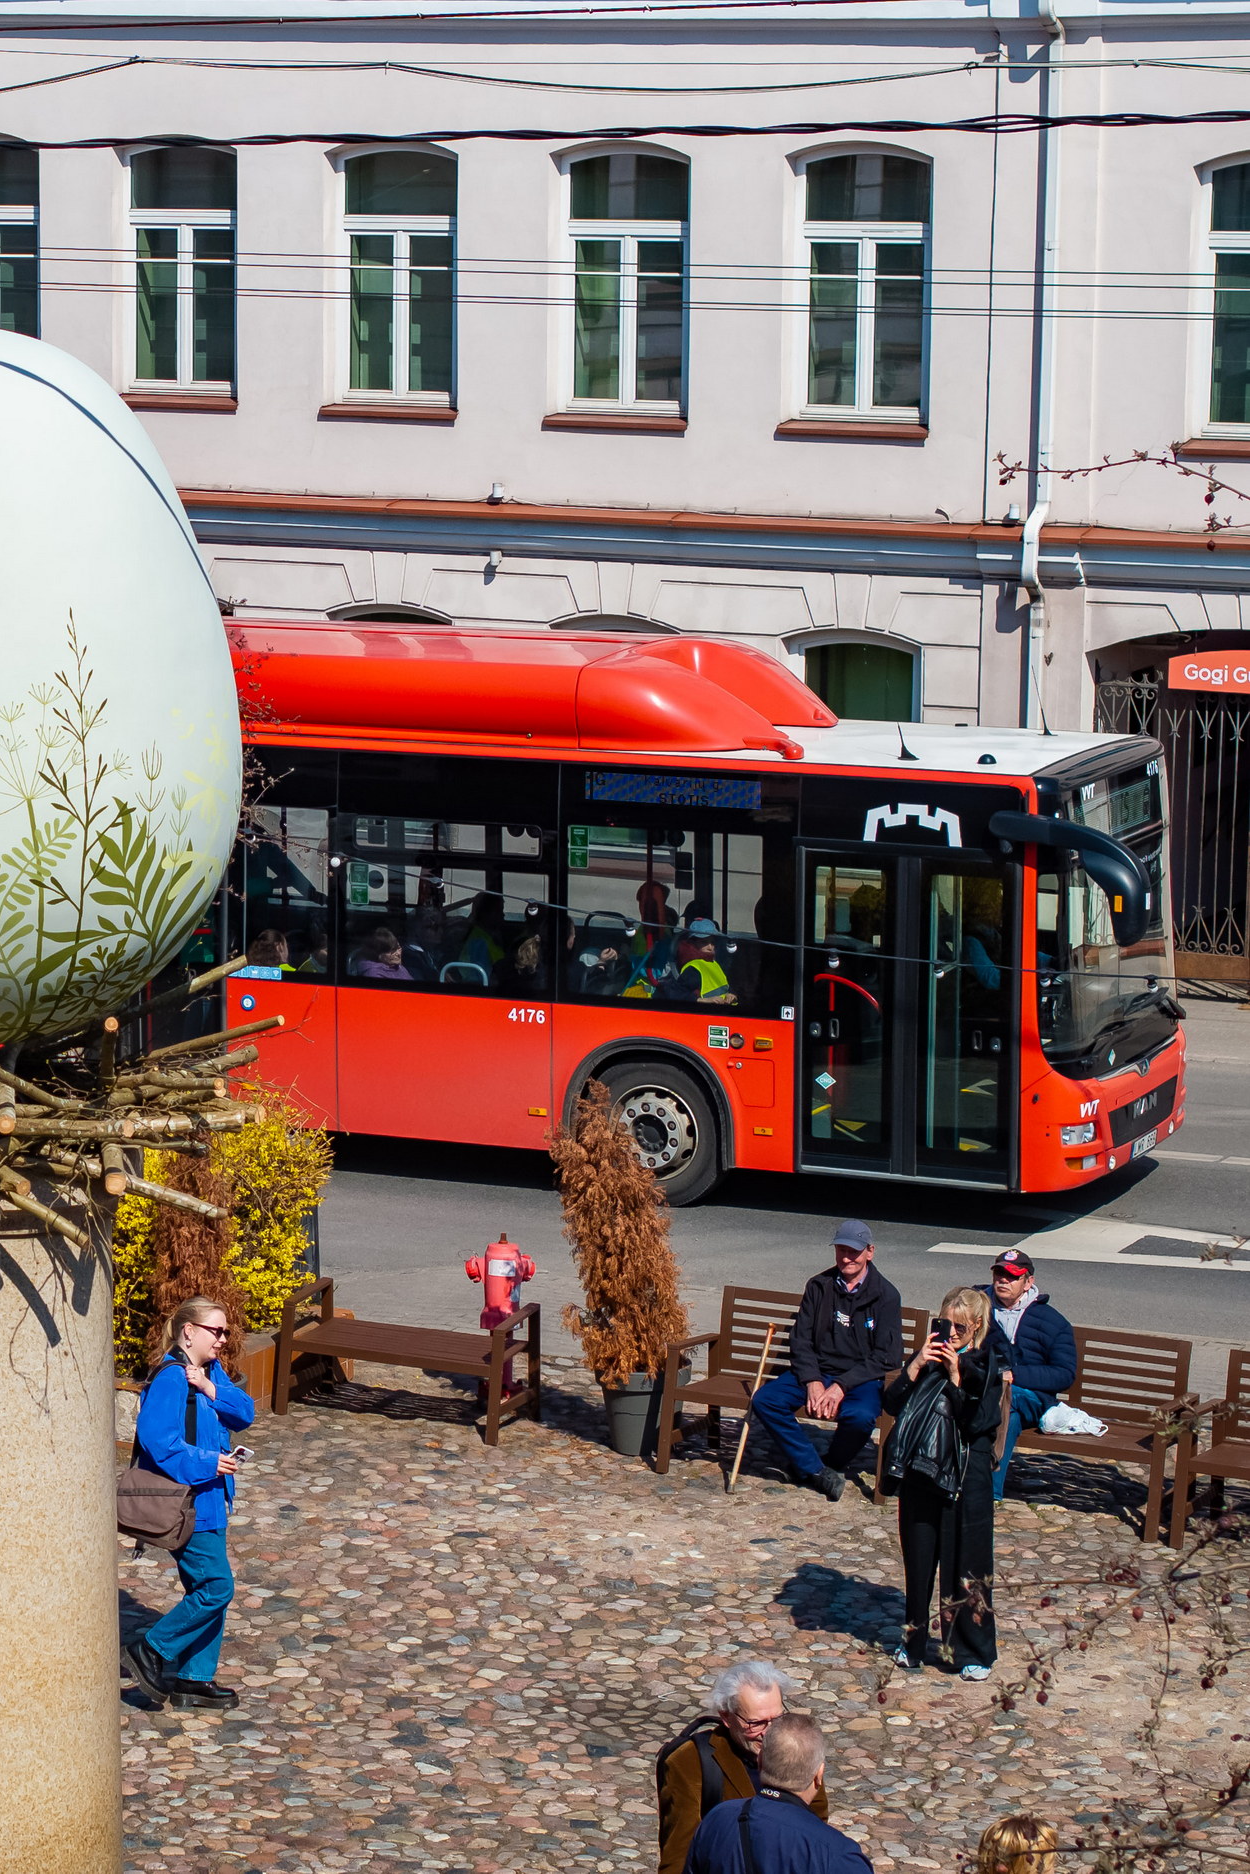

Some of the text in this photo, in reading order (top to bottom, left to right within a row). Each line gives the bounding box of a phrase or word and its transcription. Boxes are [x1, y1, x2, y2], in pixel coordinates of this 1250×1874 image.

[1184, 663, 1250, 685] Gogi G
[1146, 760, 1159, 776] 4176
[659, 792, 710, 807] STOTIS
[1081, 783, 1096, 801] VVT
[508, 1007, 546, 1024] 4176
[1080, 1099, 1101, 1118] VVT
[1133, 1092, 1158, 1119] MAN
